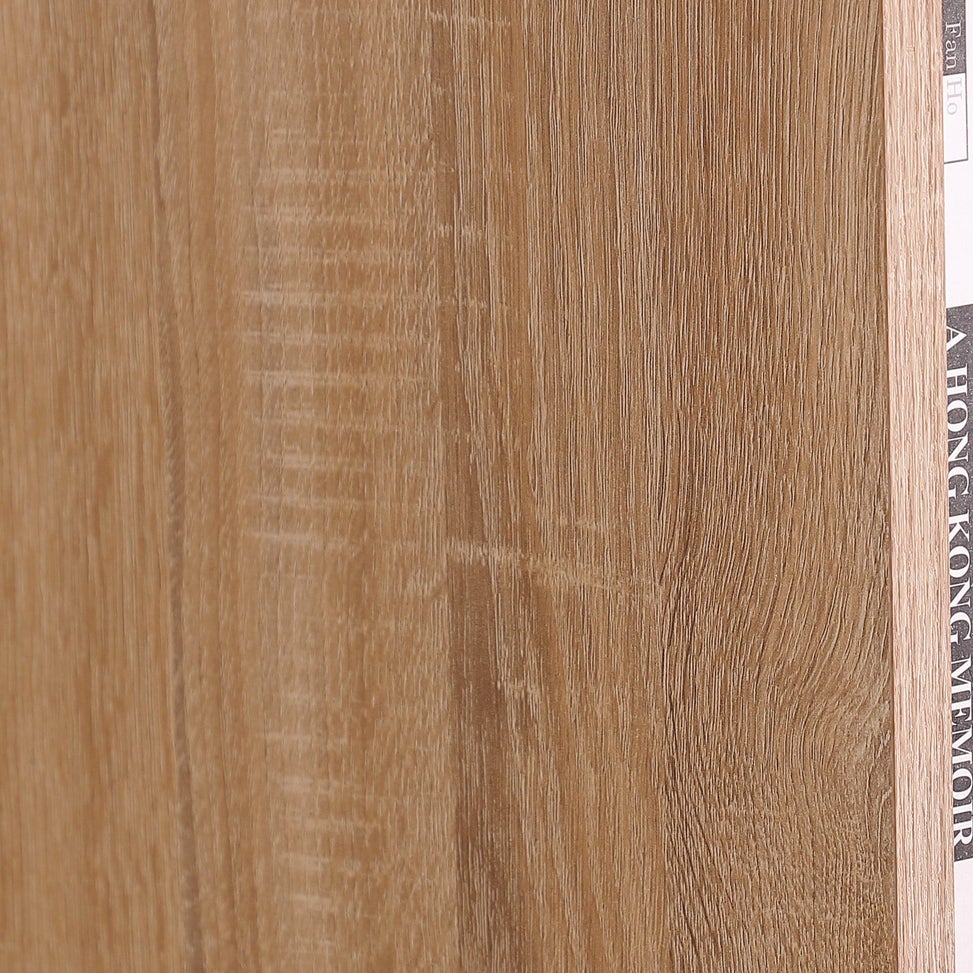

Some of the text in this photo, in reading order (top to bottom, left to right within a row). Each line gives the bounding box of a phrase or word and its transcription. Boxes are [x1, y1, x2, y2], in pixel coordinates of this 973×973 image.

[945, 21, 962, 115] Fan Ho
[946, 363, 970, 499] HONG
[948, 509, 971, 645] KONG
[951, 655, 973, 847] MEMOIR
